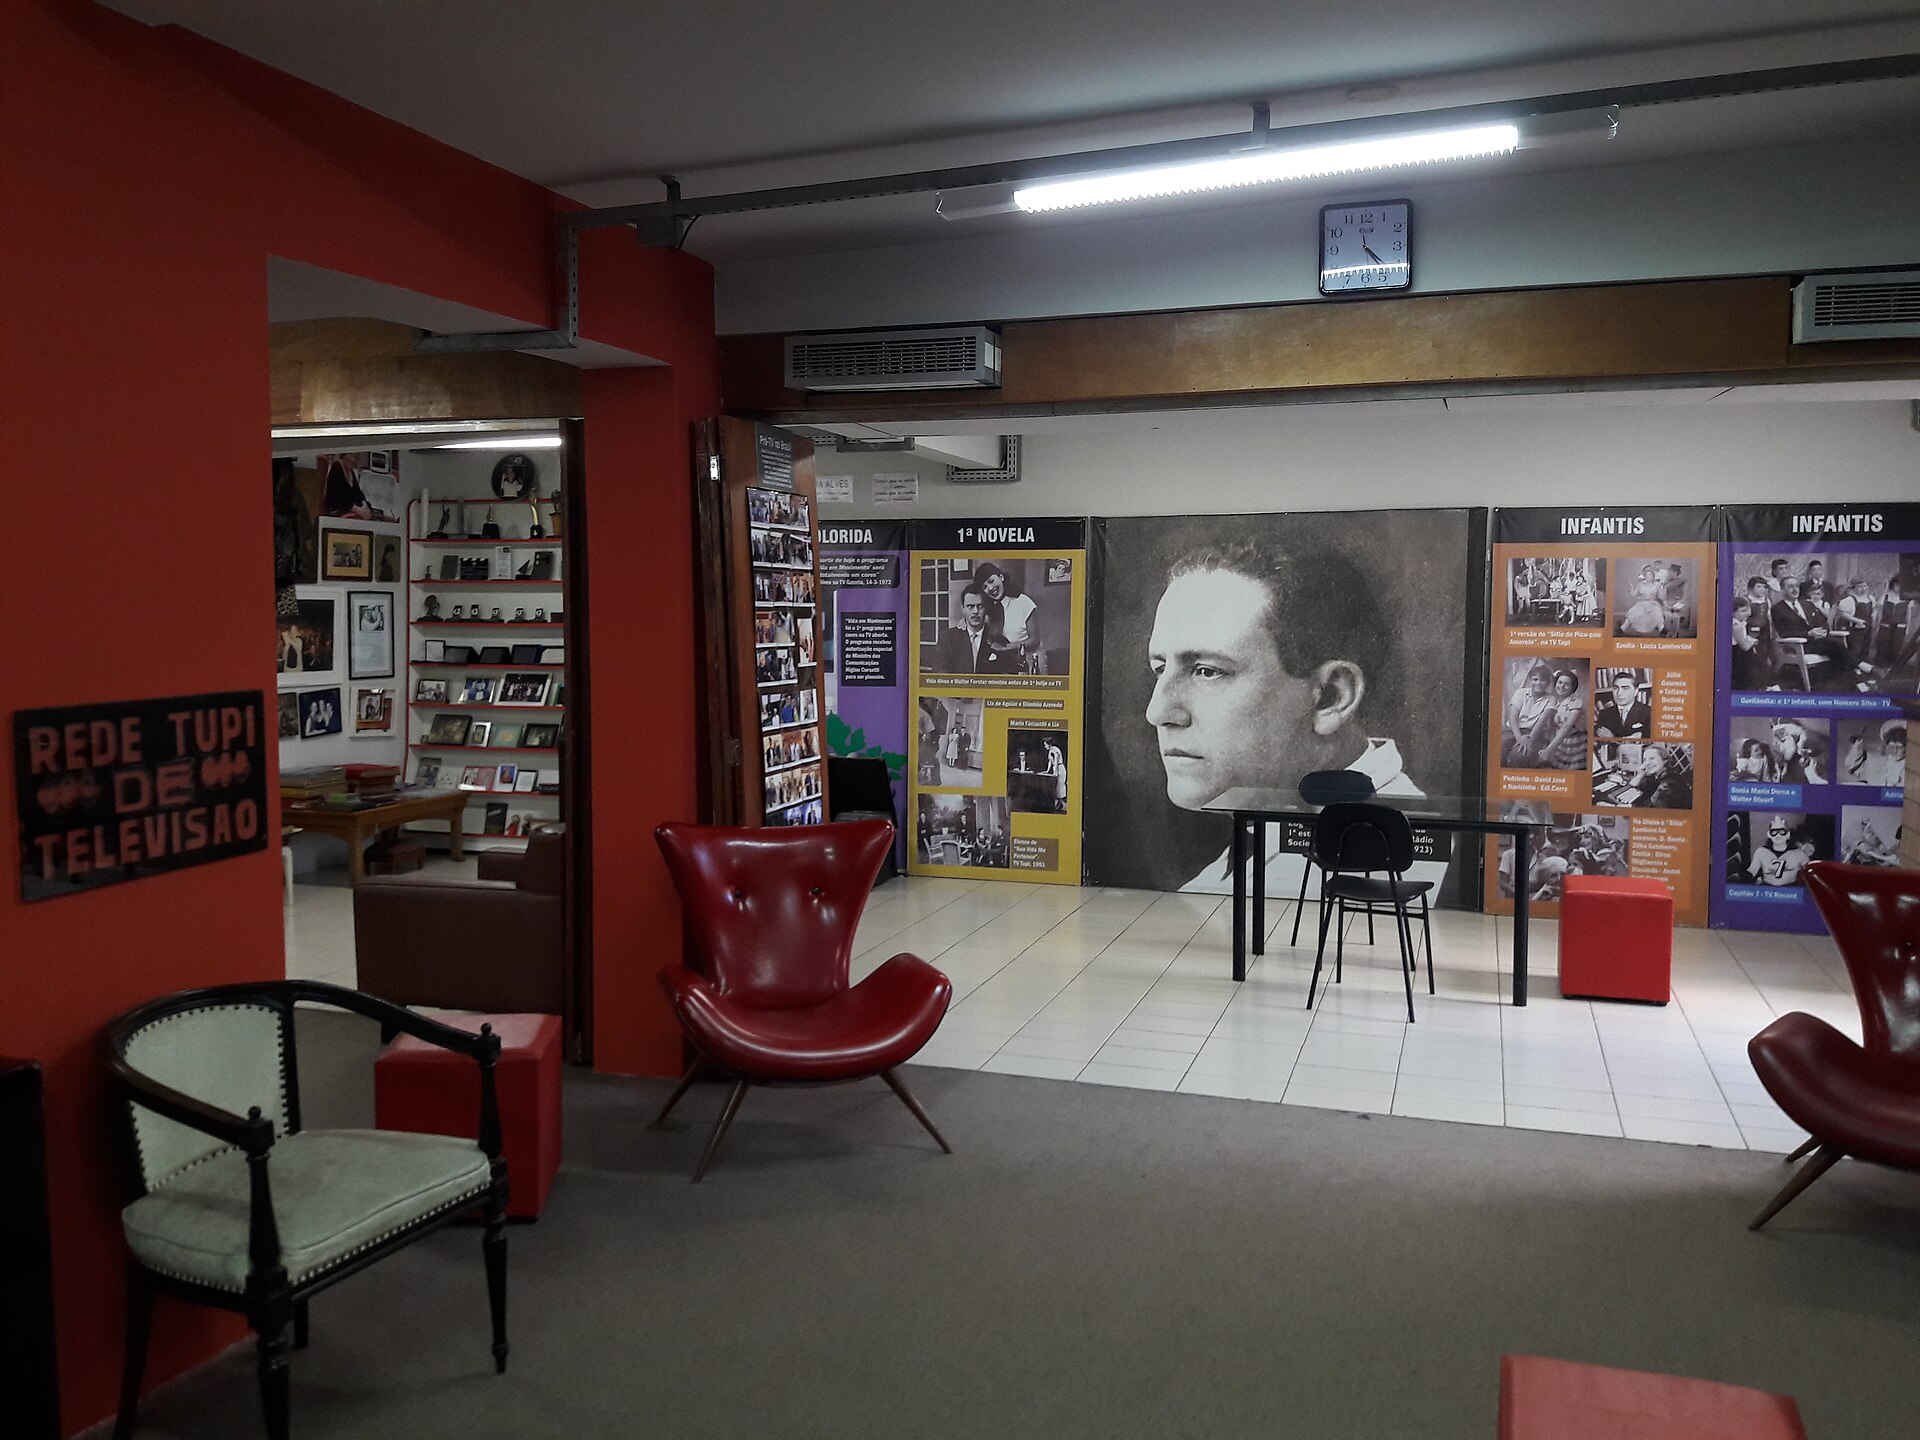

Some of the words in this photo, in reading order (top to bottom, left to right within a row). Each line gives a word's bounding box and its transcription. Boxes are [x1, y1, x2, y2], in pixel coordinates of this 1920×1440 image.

[1344, 214, 1353, 224] 11
[1360, 212, 1373, 223] 12
[1382, 212, 1386, 222] 1
[1330, 227, 1342, 238] 10
[1393, 222, 1402, 232] 2
[1330, 245, 1339, 256] 9
[1393, 240, 1402, 251] 3
[1345, 274, 1351, 284] 7
[1361, 273, 1370, 284] 6
[1379, 271, 1387, 282] 5
[1560, 517, 1645, 534] INFANTIS
[1792, 514, 1884, 533] INFANTIS
[958, 528, 972, 542] 1ª
[978, 528, 1035, 542] NOVELA
[28, 716, 143, 775] REDE
[168, 705, 256, 756] TUPI
[113, 760, 196, 814] DE
[34, 799, 258, 881] TELEVISAO
[1414, 845, 1432, 855] 923)
